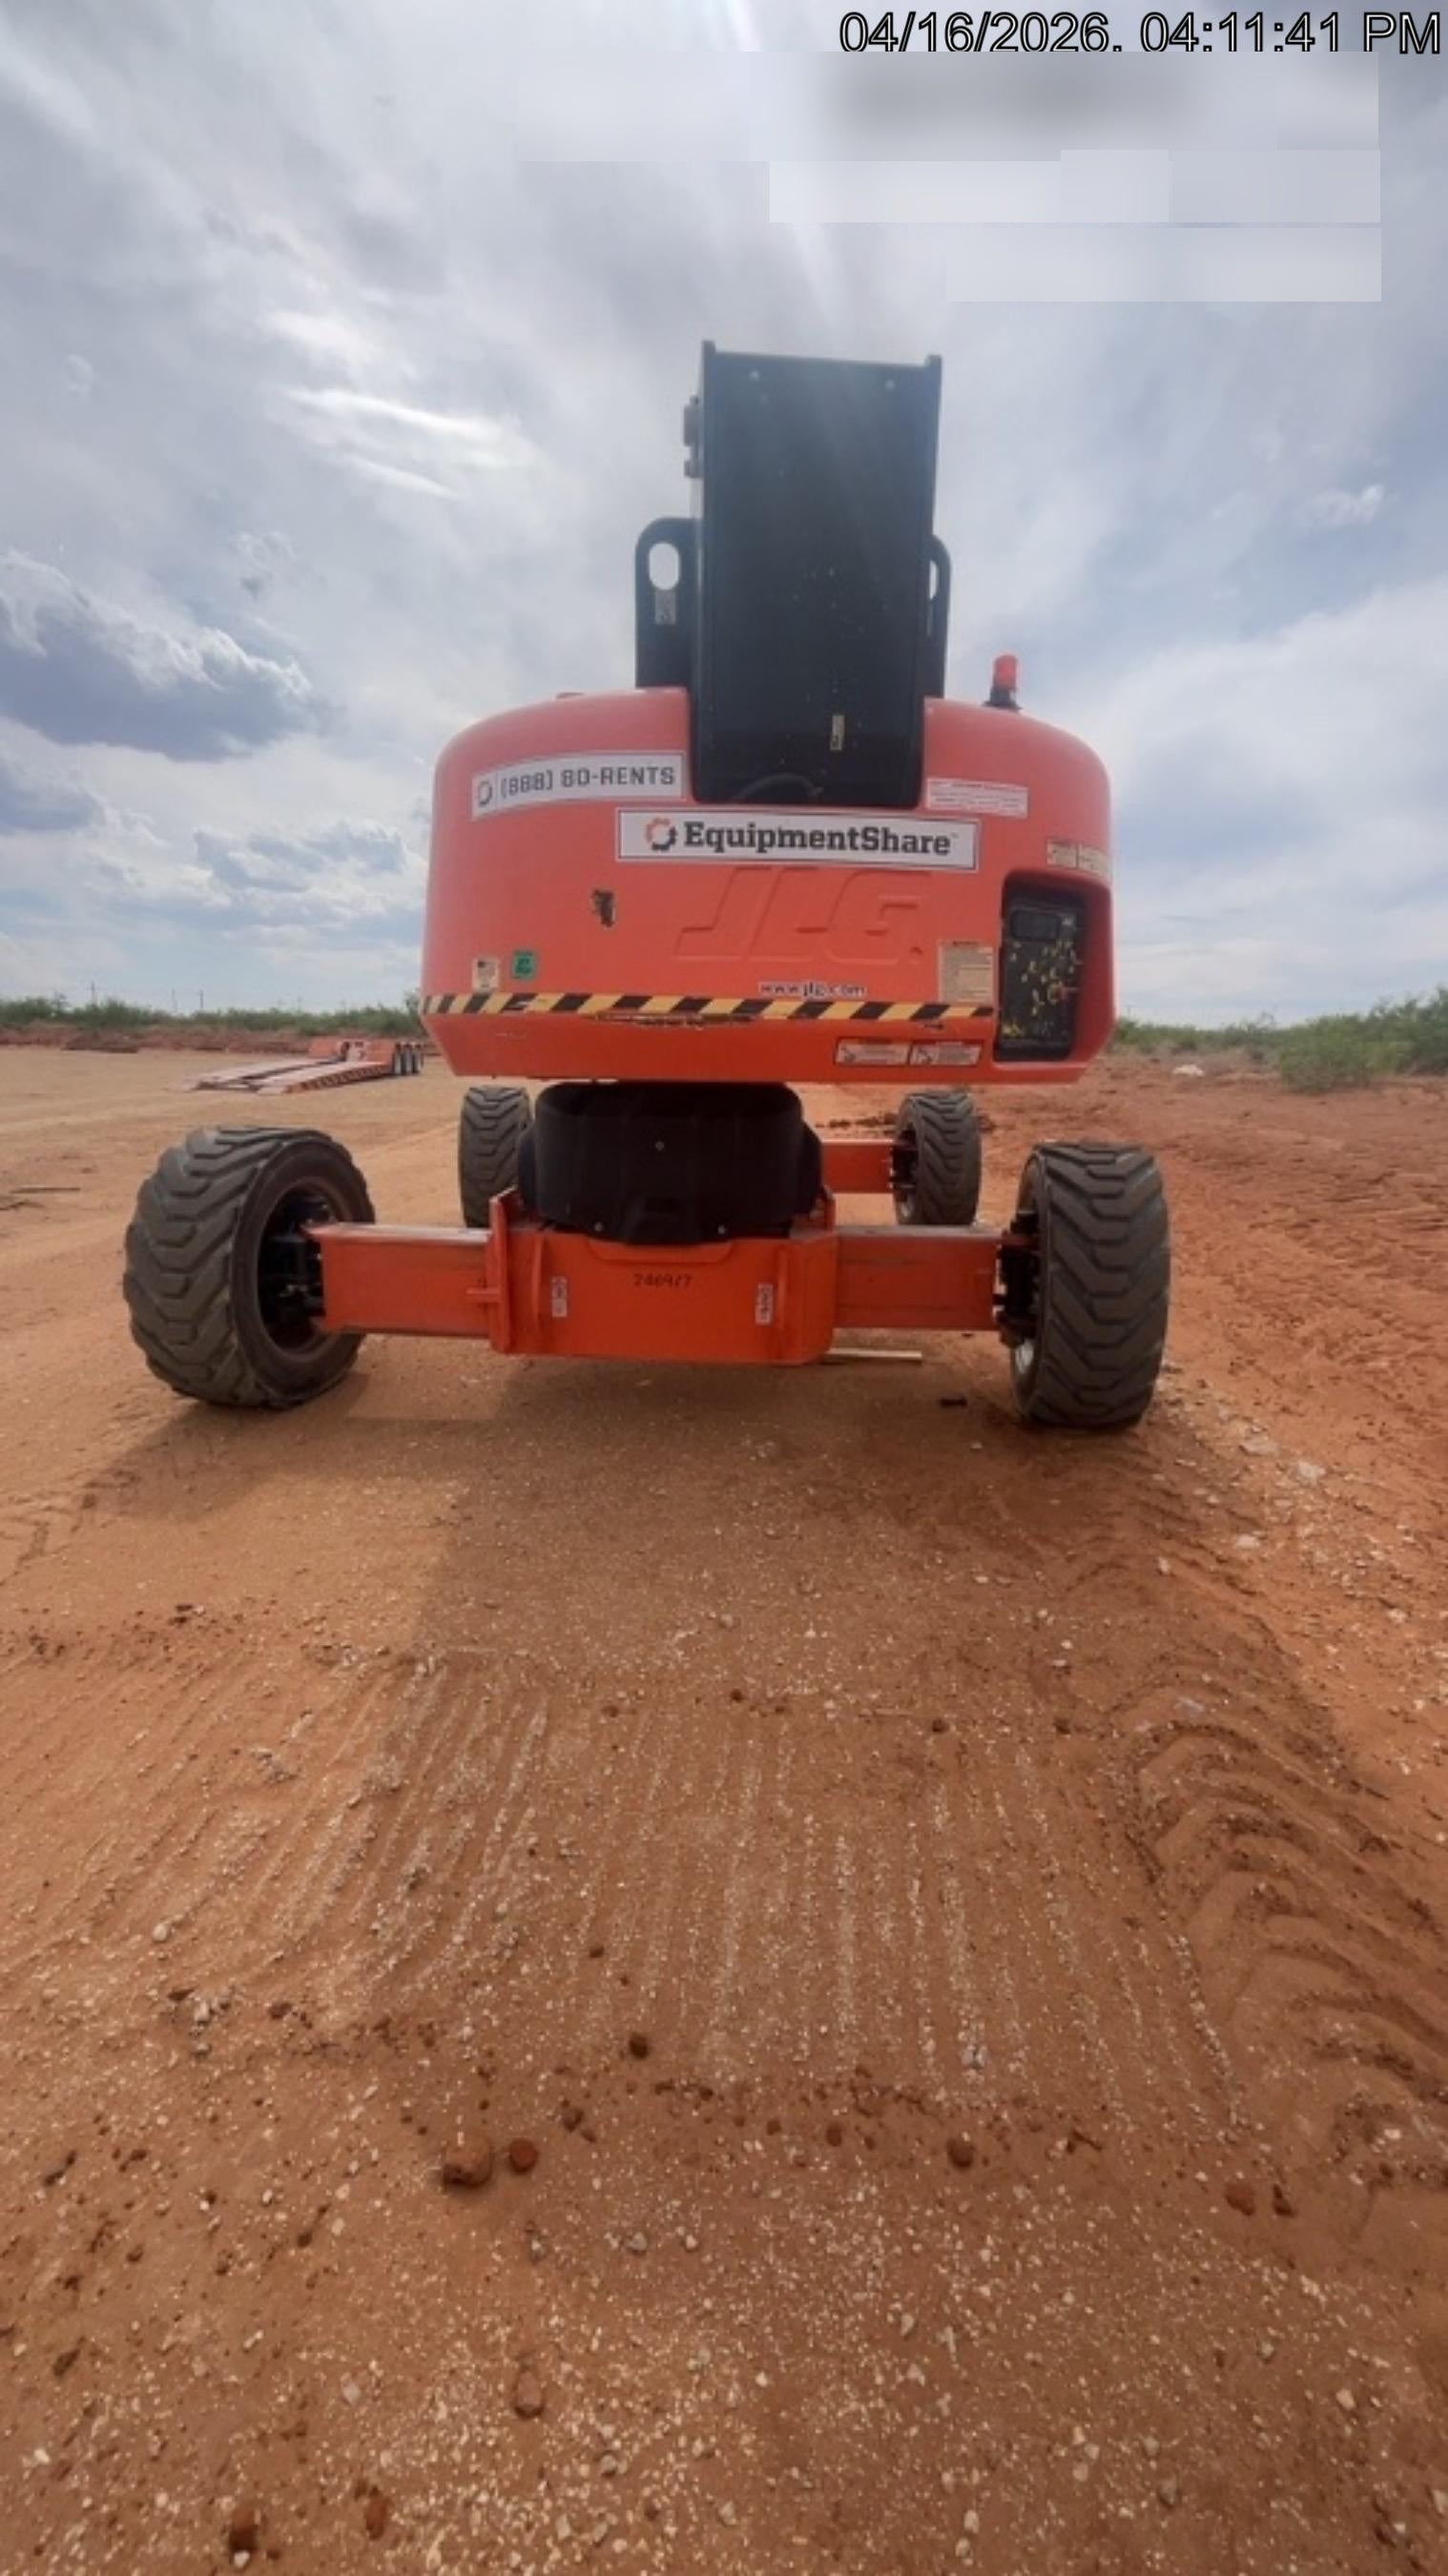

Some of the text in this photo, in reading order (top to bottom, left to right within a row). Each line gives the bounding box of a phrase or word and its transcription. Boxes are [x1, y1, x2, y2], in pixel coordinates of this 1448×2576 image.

[500, 766, 675, 800] (888) 80-RENTS
[683, 821, 951, 857] EquipmentShare
